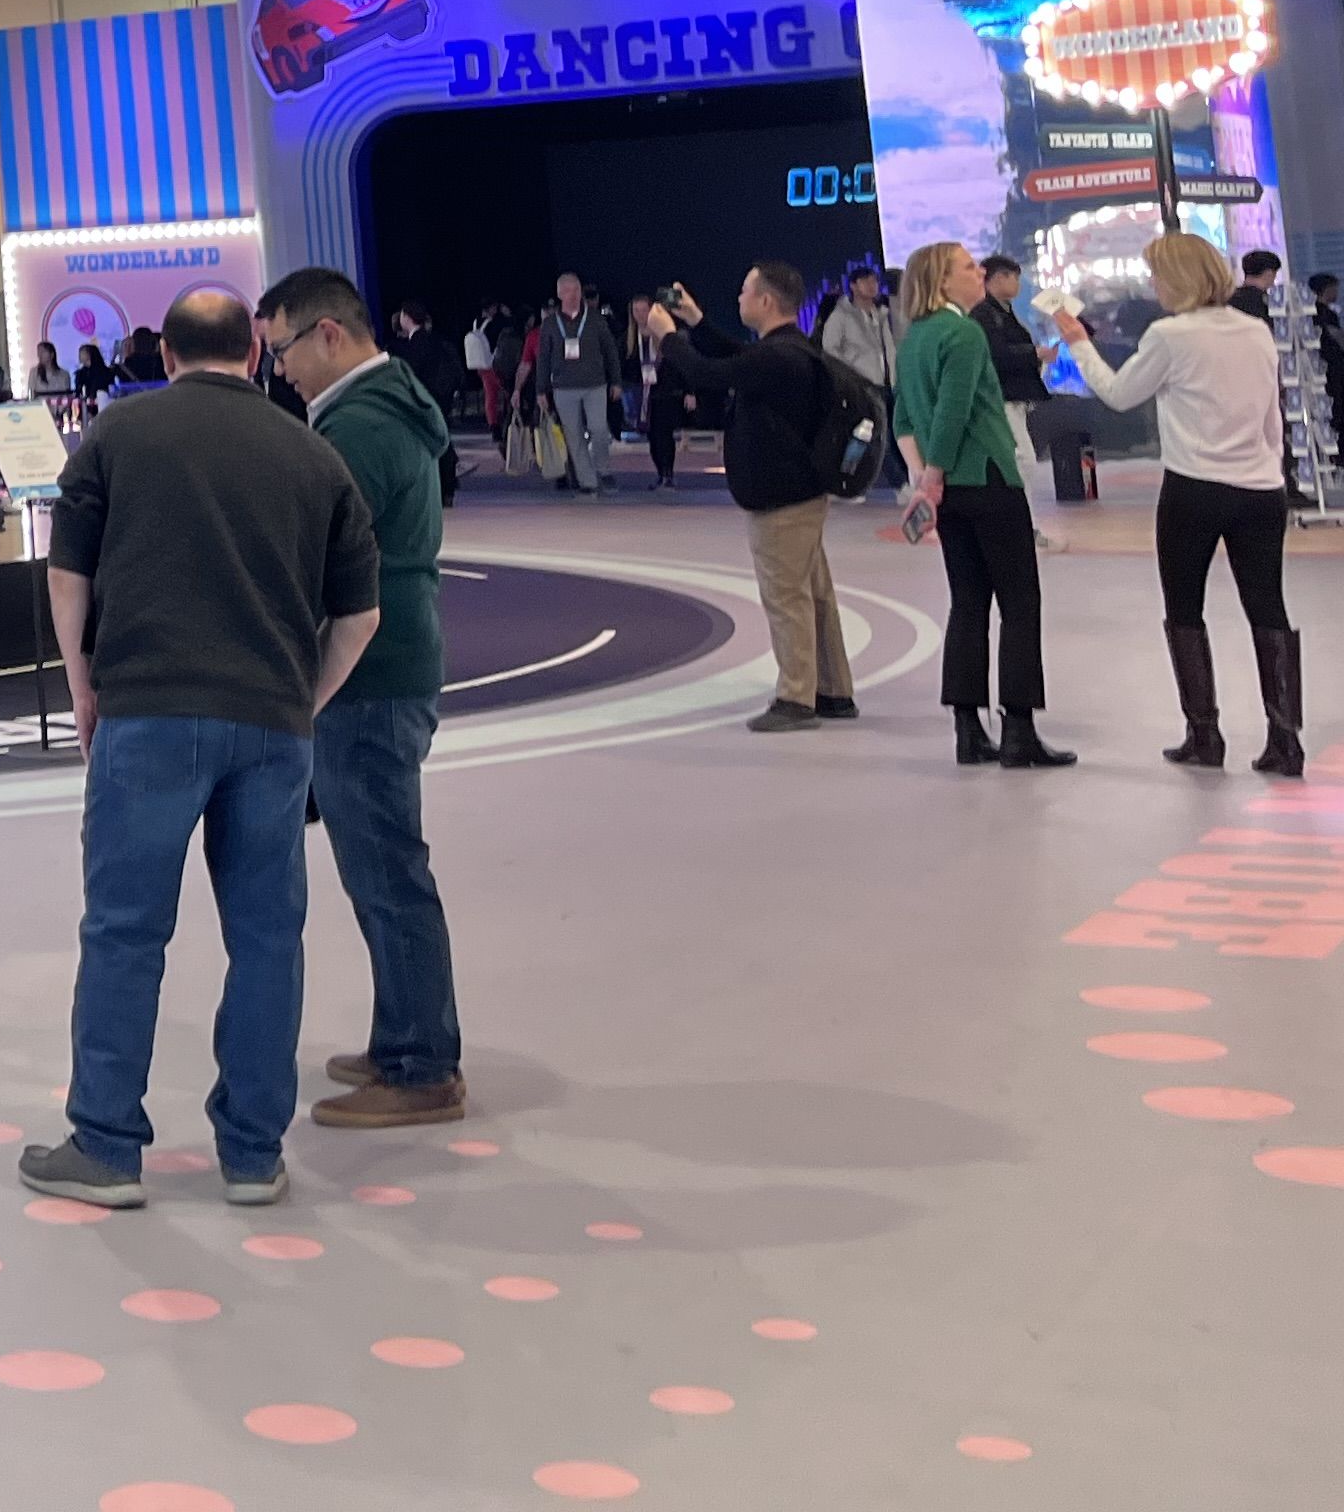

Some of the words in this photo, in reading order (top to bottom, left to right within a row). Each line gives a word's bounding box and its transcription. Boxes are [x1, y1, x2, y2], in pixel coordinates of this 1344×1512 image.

[444, 4, 814, 97] DANCING
[1054, 14, 1243, 60] WONDERLAND
[1035, 175, 1075, 193] TRAIN
[1076, 167, 1152, 189] ADVENTURE
[64, 246, 221, 273] WONDERLAND
